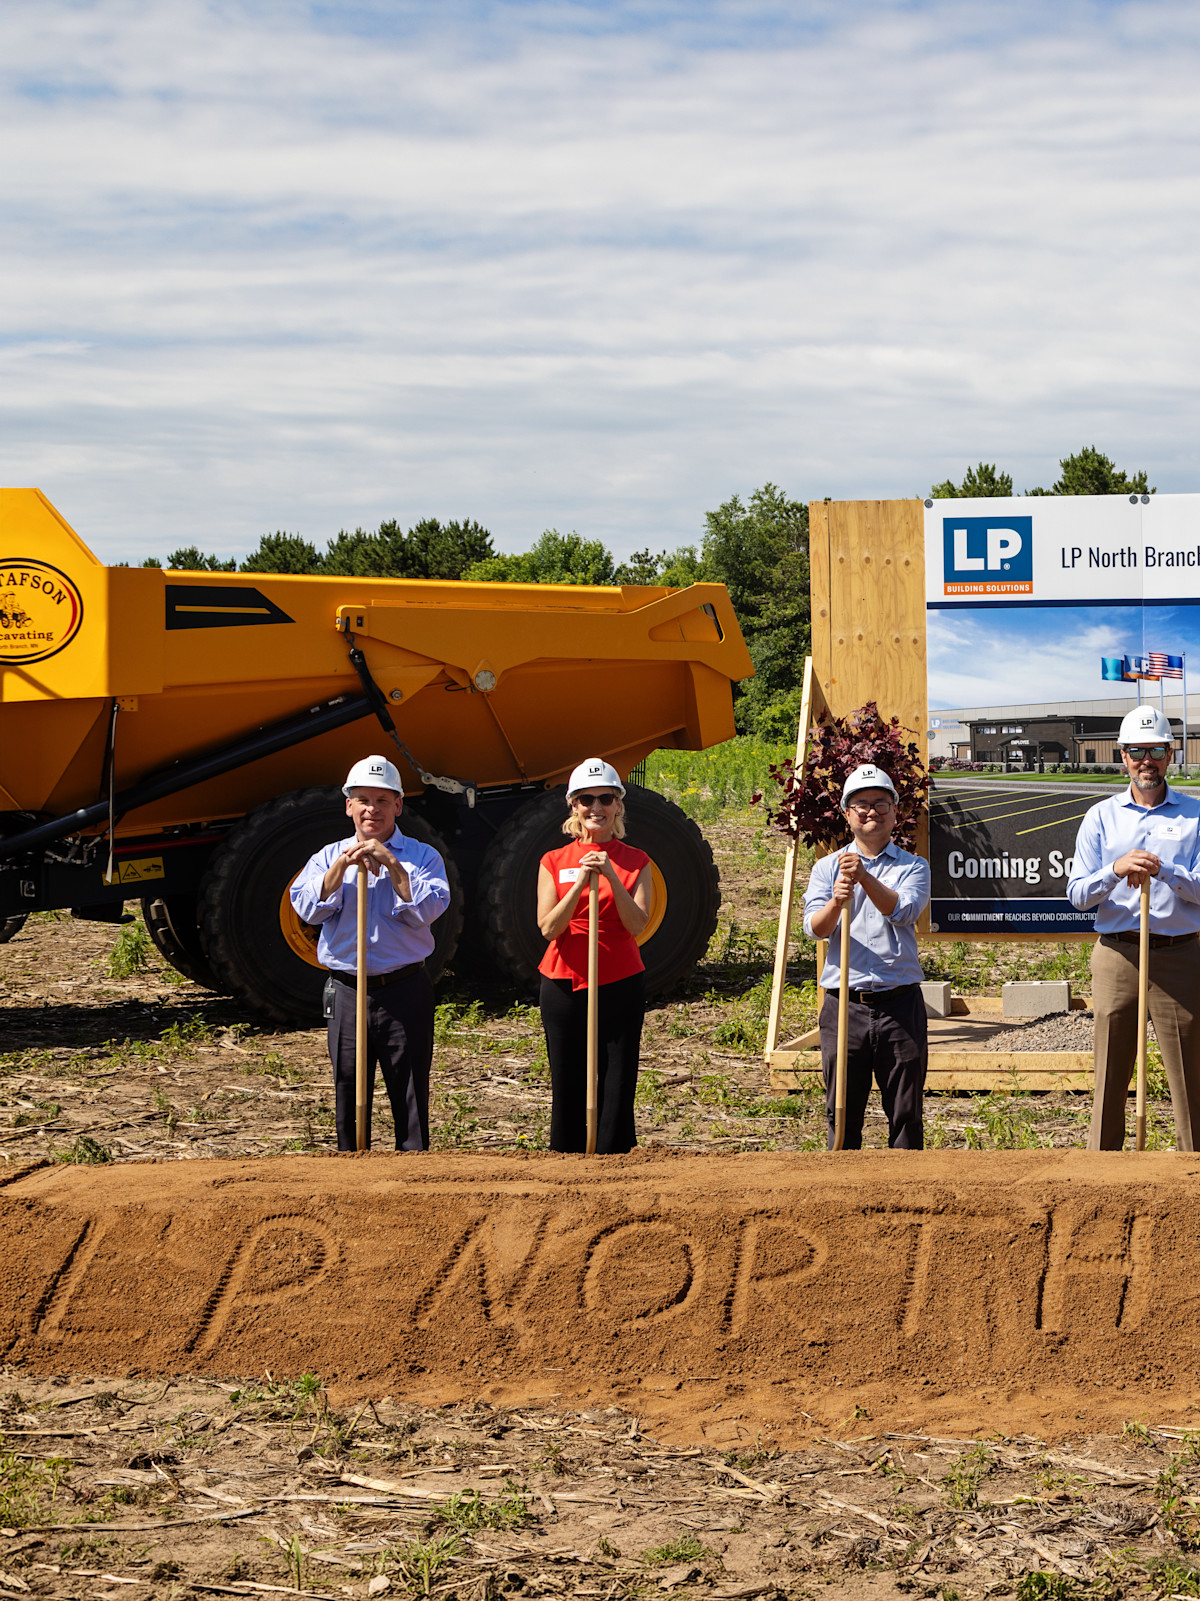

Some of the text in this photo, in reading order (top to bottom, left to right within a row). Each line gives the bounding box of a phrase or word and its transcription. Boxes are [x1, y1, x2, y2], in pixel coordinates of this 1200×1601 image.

[1061, 547, 1082, 568] LP
[1088, 546, 1137, 568] North
[947, 584, 1030, 593] BUILDING SOLUTIONS
[1141, 719, 1152, 727] LP
[589, 766, 600, 774] LP
[947, 850, 1042, 884] Coming
[947, 913, 961, 921] OUR
[961, 912, 1004, 921] COMMITMENT
[1004, 912, 1031, 921] REACHES
[1031, 912, 1055, 921] BEYOND
[1056, 912, 1098, 921] CONSTRUCTIO
[30, 1209, 348, 1358] LP
